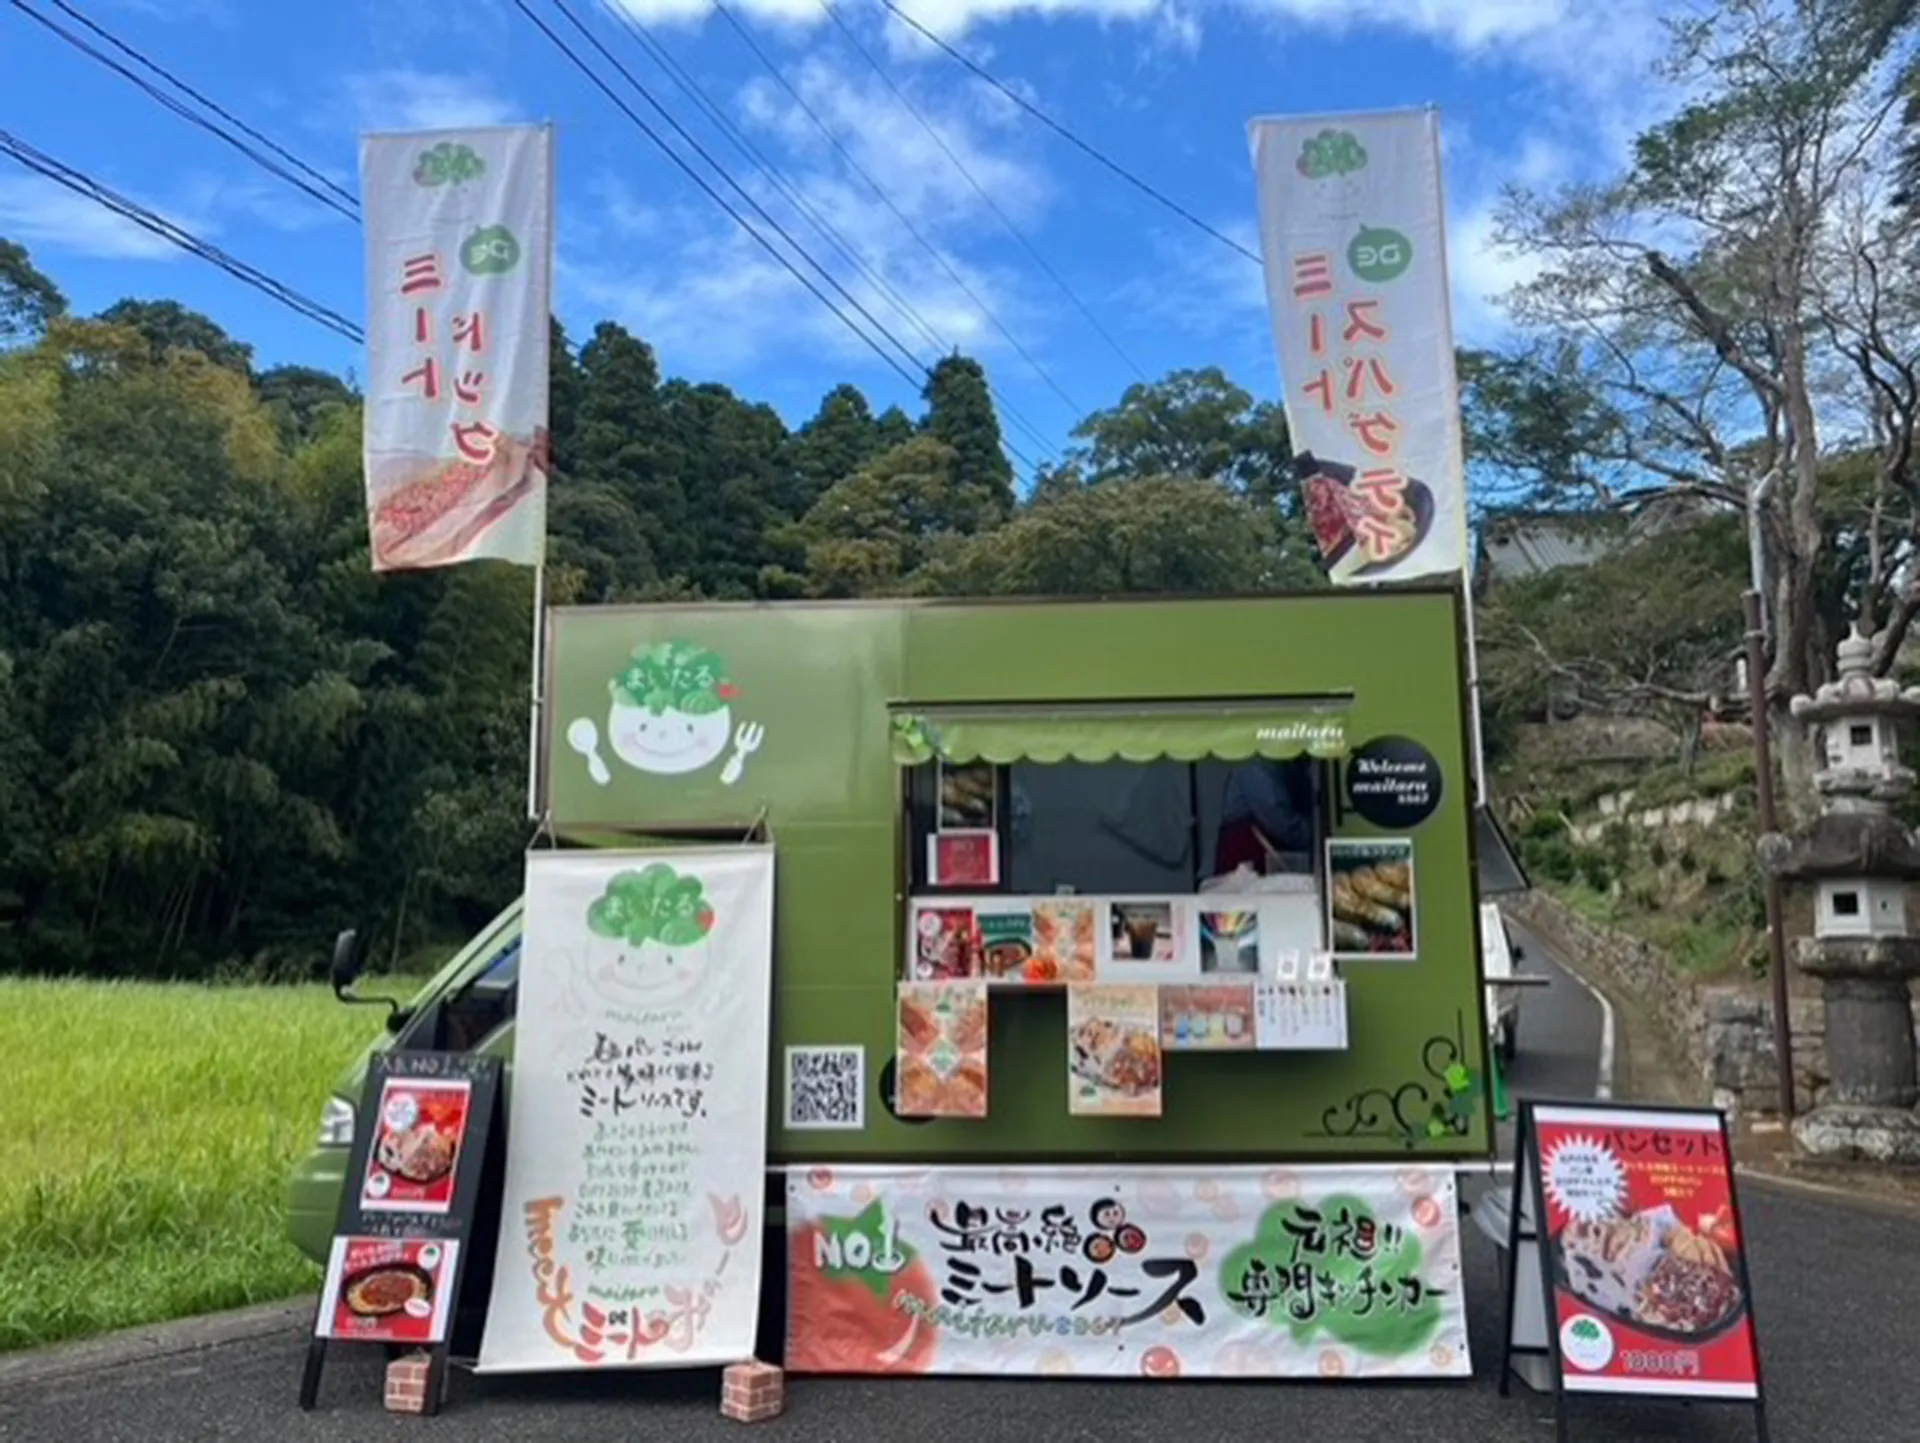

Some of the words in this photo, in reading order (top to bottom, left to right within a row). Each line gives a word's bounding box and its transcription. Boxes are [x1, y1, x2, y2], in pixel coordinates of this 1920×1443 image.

[626, 664, 715, 688] まいたる
[1357, 758, 1427, 774] Welcome
[940, 1253, 1206, 1327] ミートソース
